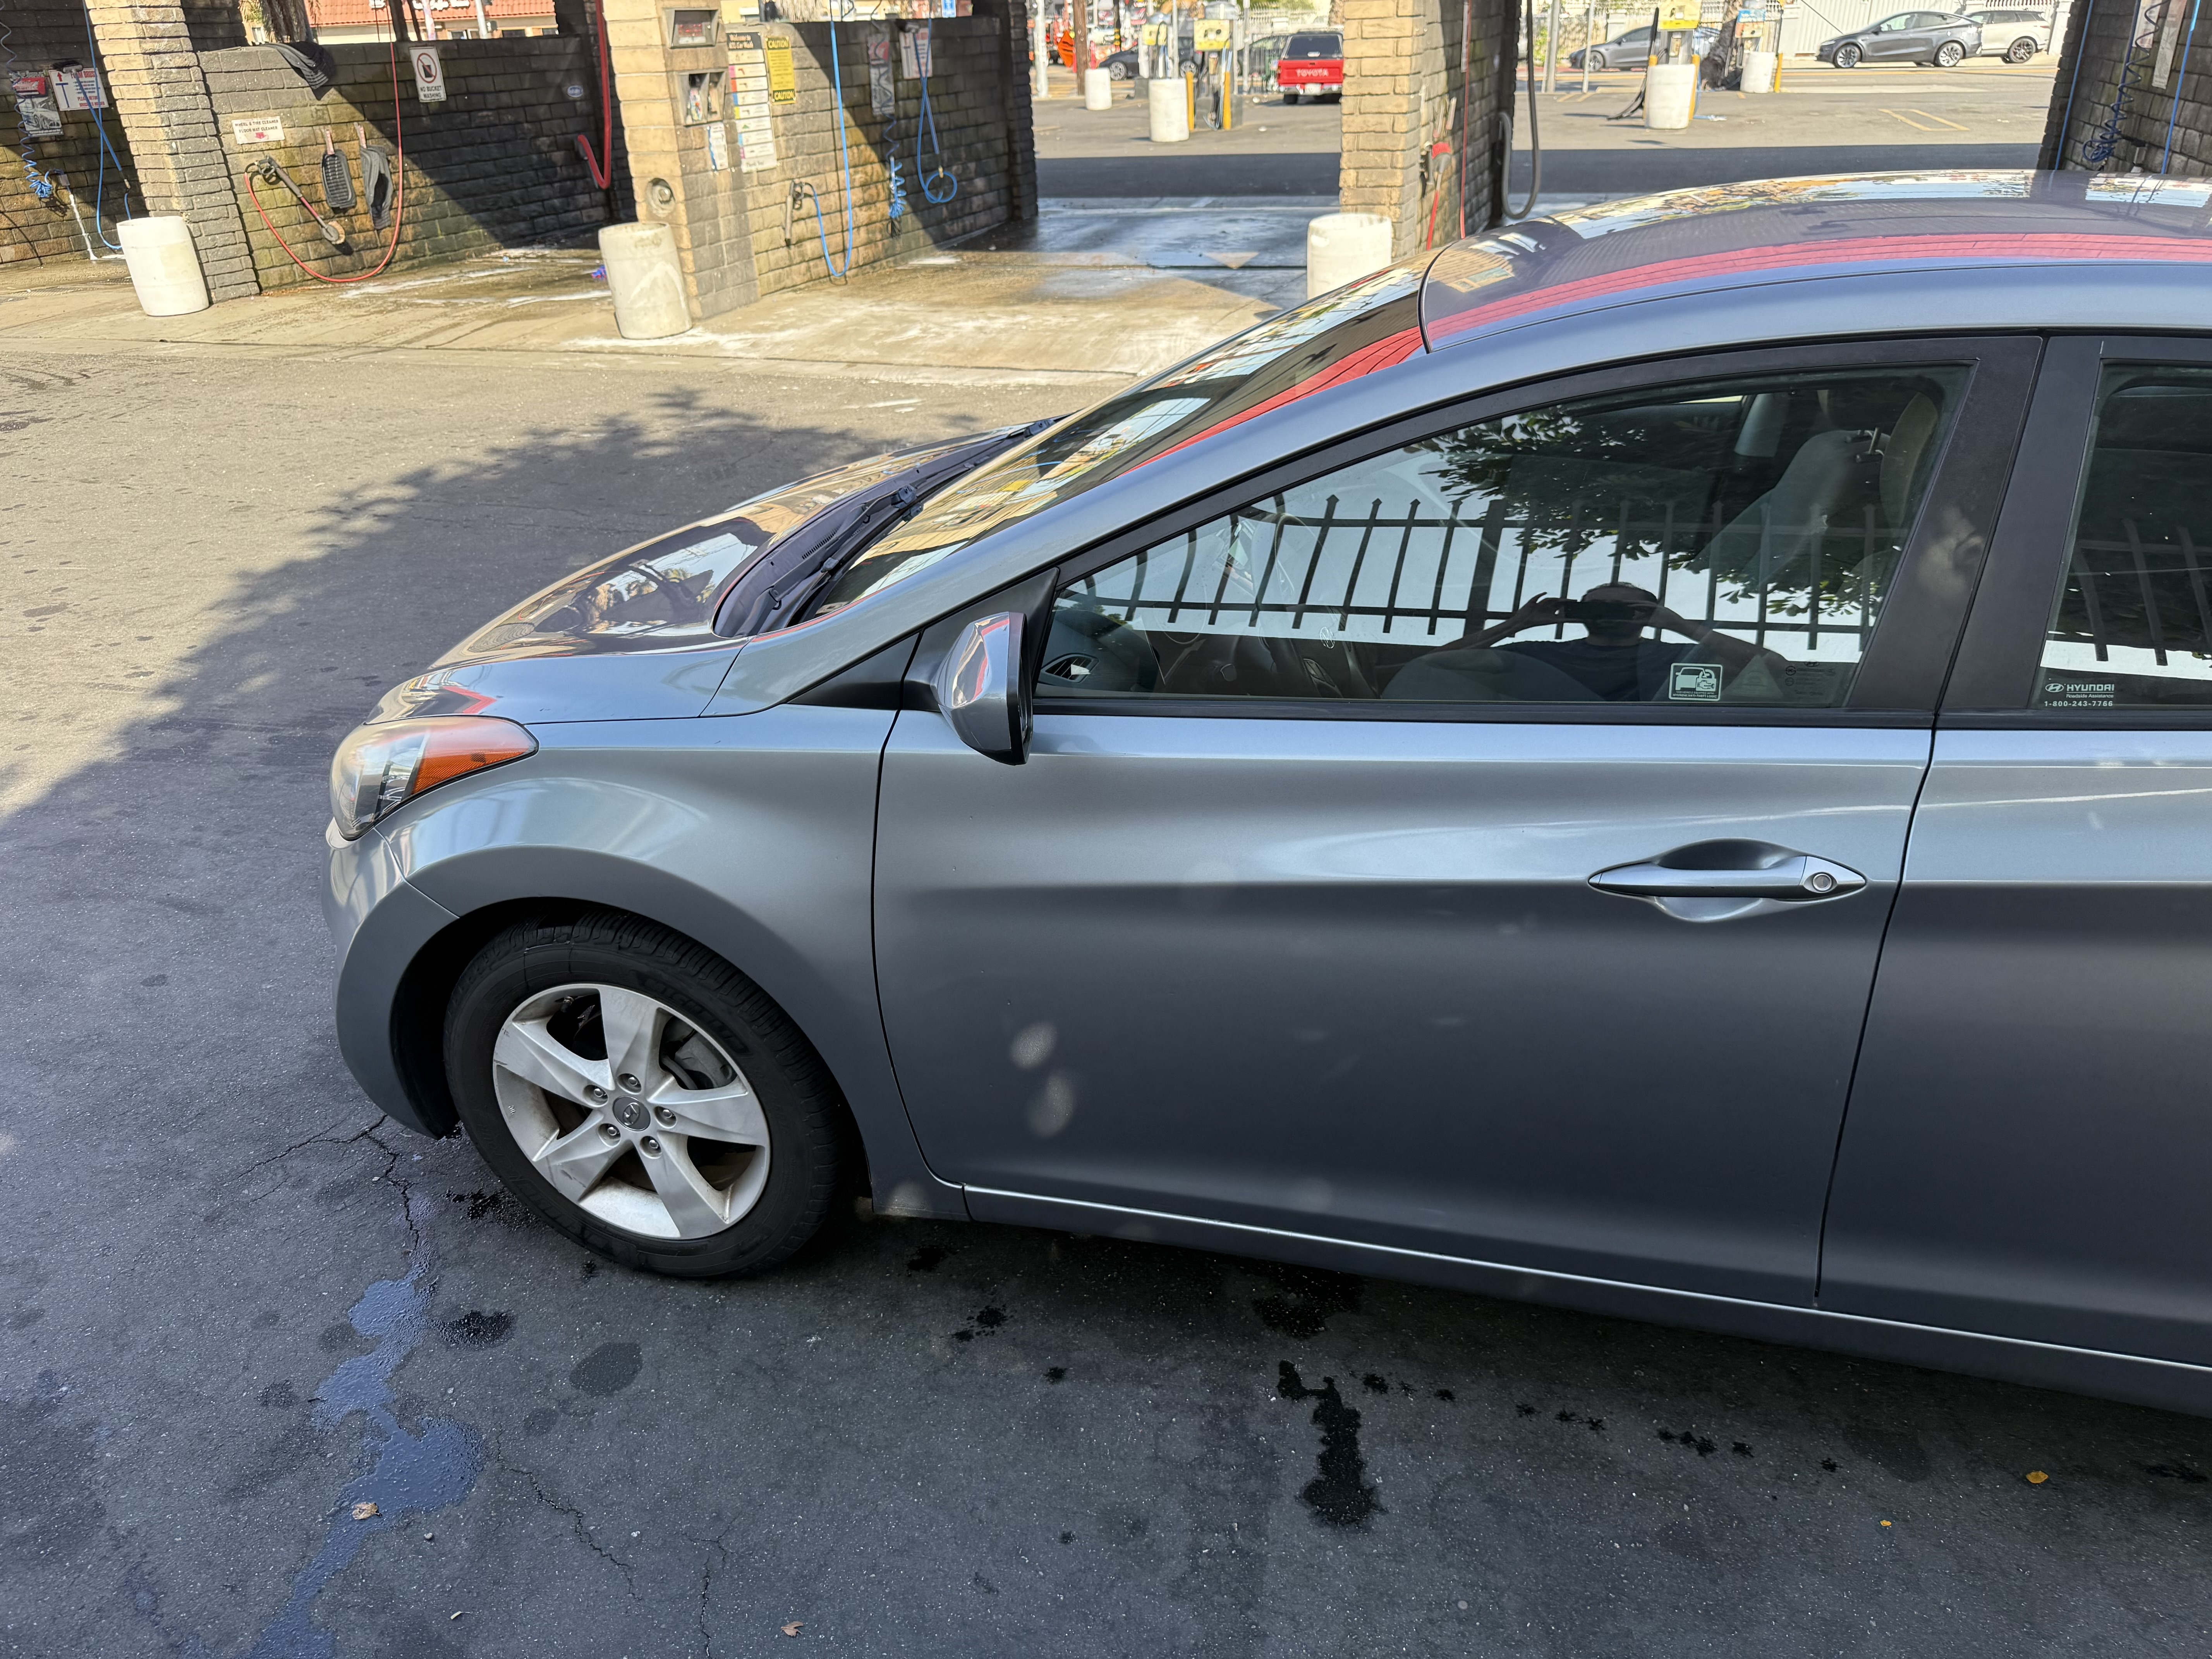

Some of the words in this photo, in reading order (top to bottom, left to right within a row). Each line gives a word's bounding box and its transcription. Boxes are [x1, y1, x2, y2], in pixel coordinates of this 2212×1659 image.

[768, 40, 788, 48] CAUTION
[1296, 69, 1329, 77] TOYOTA
[774, 91, 794, 100] CAUTION
